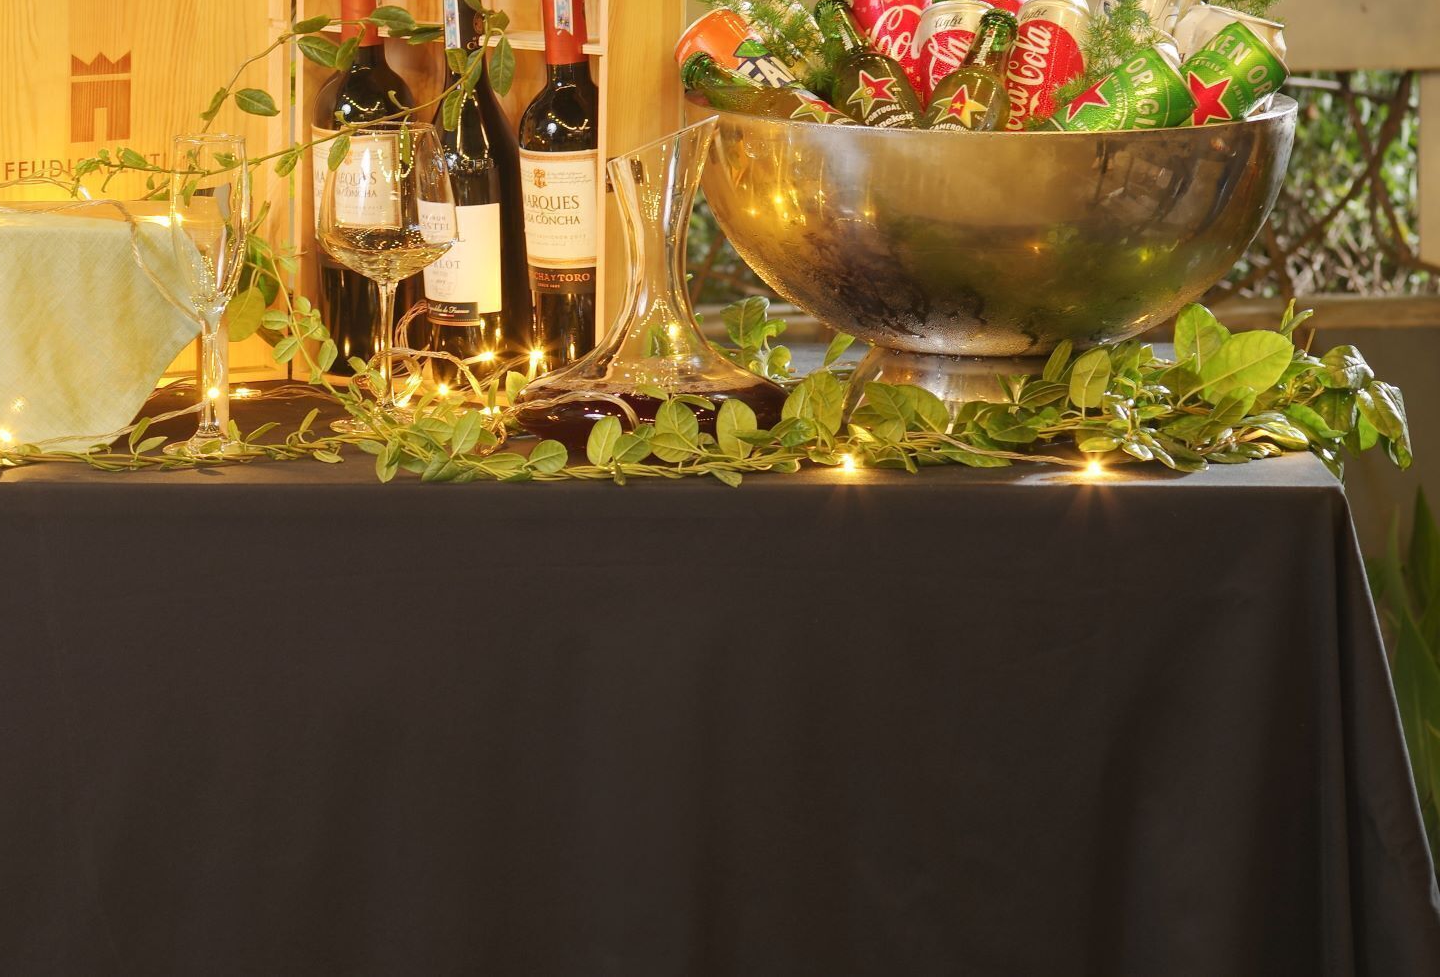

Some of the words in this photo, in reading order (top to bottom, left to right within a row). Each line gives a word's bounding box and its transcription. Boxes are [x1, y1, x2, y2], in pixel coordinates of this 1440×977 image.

[1125, 57, 1160, 128] ORIGI
[864, 103, 902, 125] PORTUGAL
[536, 215, 581, 226] CONCHA
